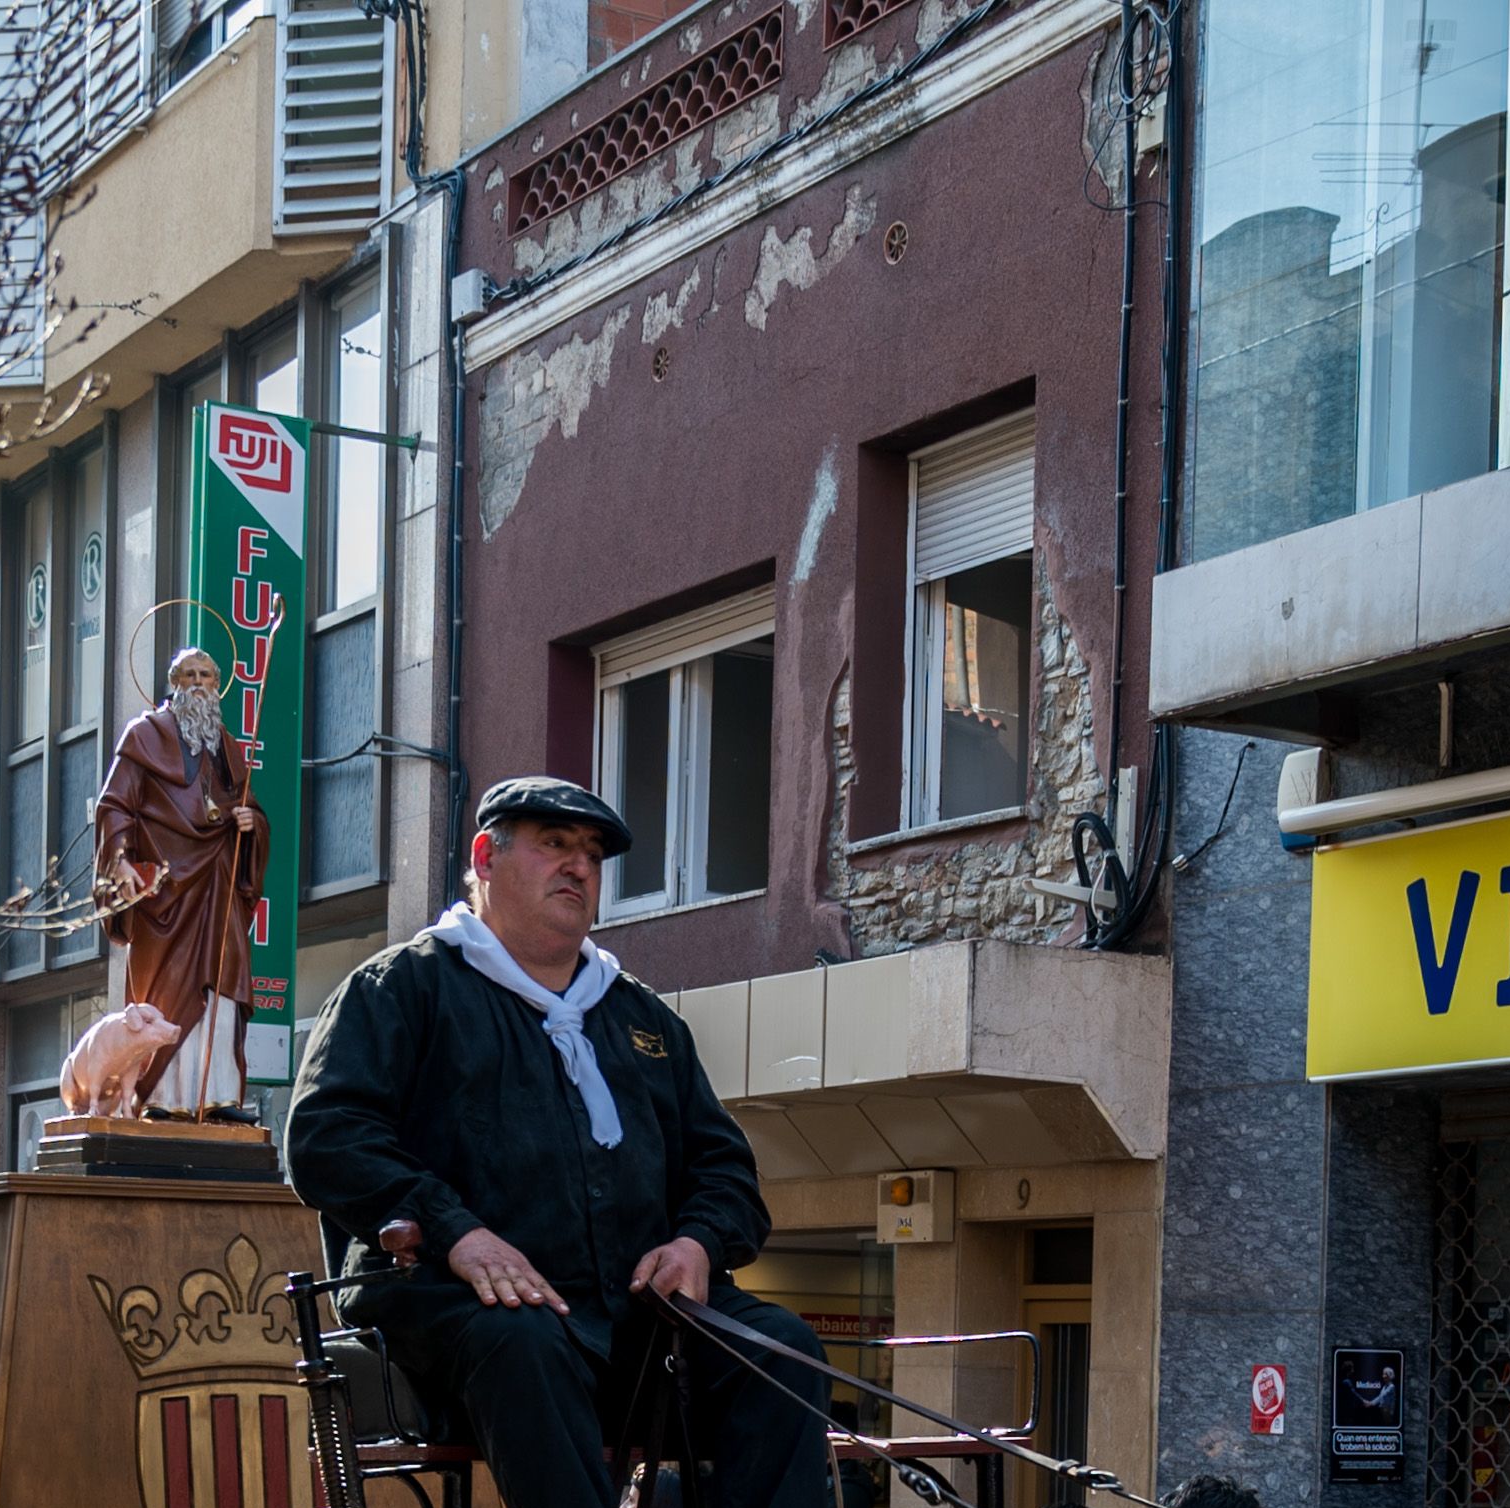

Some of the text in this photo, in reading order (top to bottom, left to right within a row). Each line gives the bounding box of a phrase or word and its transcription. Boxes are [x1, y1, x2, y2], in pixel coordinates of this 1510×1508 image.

[219, 414, 289, 482] FUJI
[232, 525, 270, 946] FUJIF
[1017, 1178, 1031, 1210] 9
